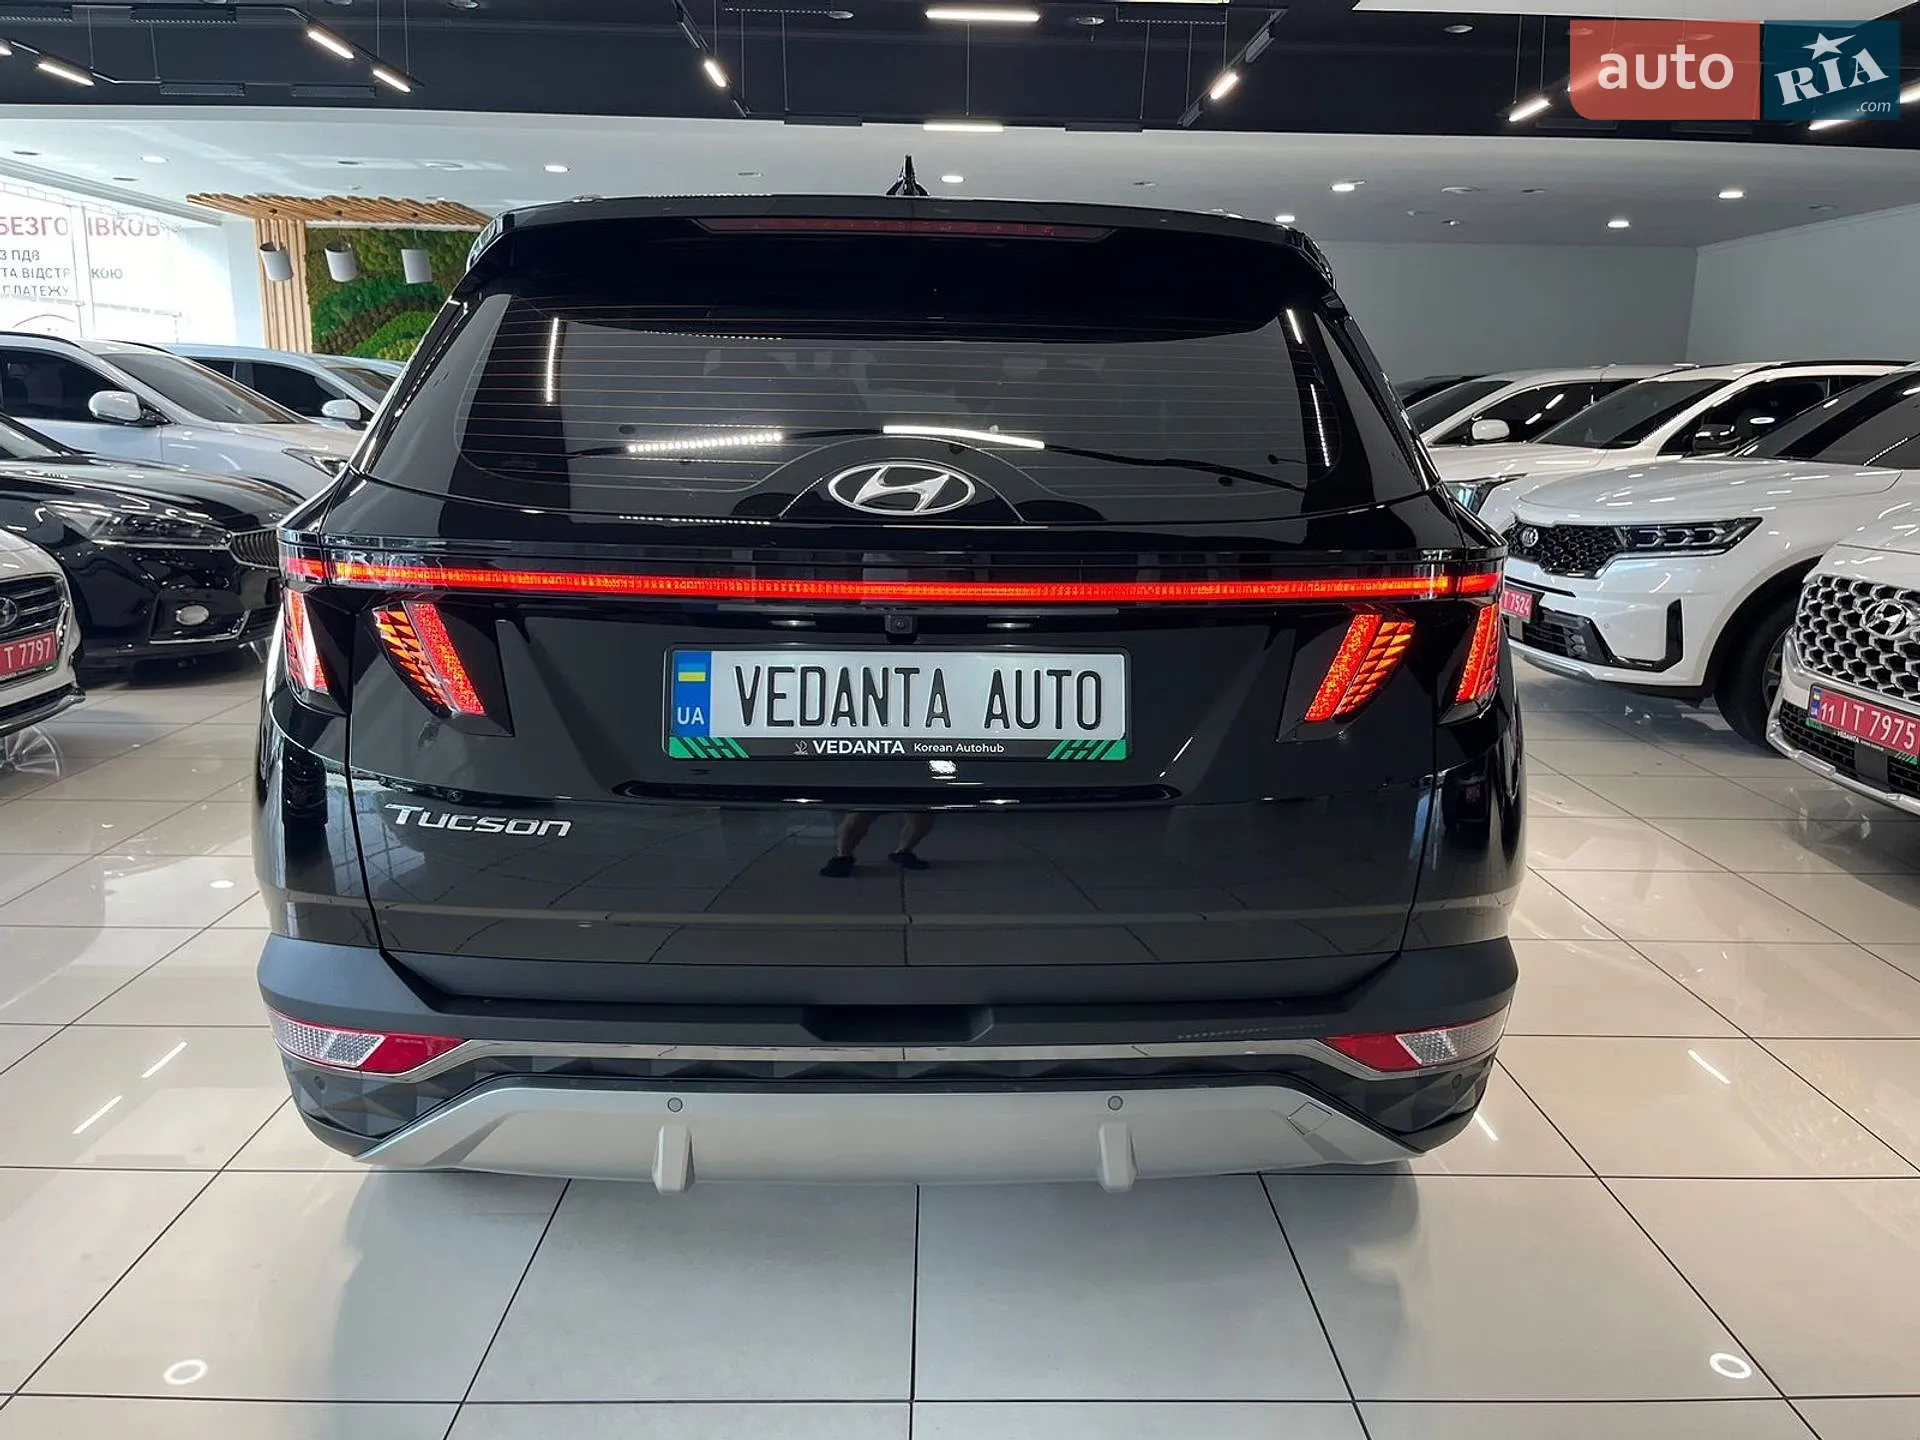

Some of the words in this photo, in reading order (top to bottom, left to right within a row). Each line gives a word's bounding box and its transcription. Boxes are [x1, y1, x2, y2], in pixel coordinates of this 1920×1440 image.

[11, 249, 40, 263] ПДВ
[4, 646, 14, 669] T
[19, 638, 51, 666] 7797
[734, 665, 953, 728] VEDANTA
[984, 669, 1103, 730] AUTO
[677, 706, 705, 726] UA
[1821, 703, 1835, 723] 11
[1869, 710, 1916, 750] 7975
[813, 740, 905, 754] VEDANTA
[914, 743, 953, 753] Korean
[956, 743, 1004, 754] Autohub
